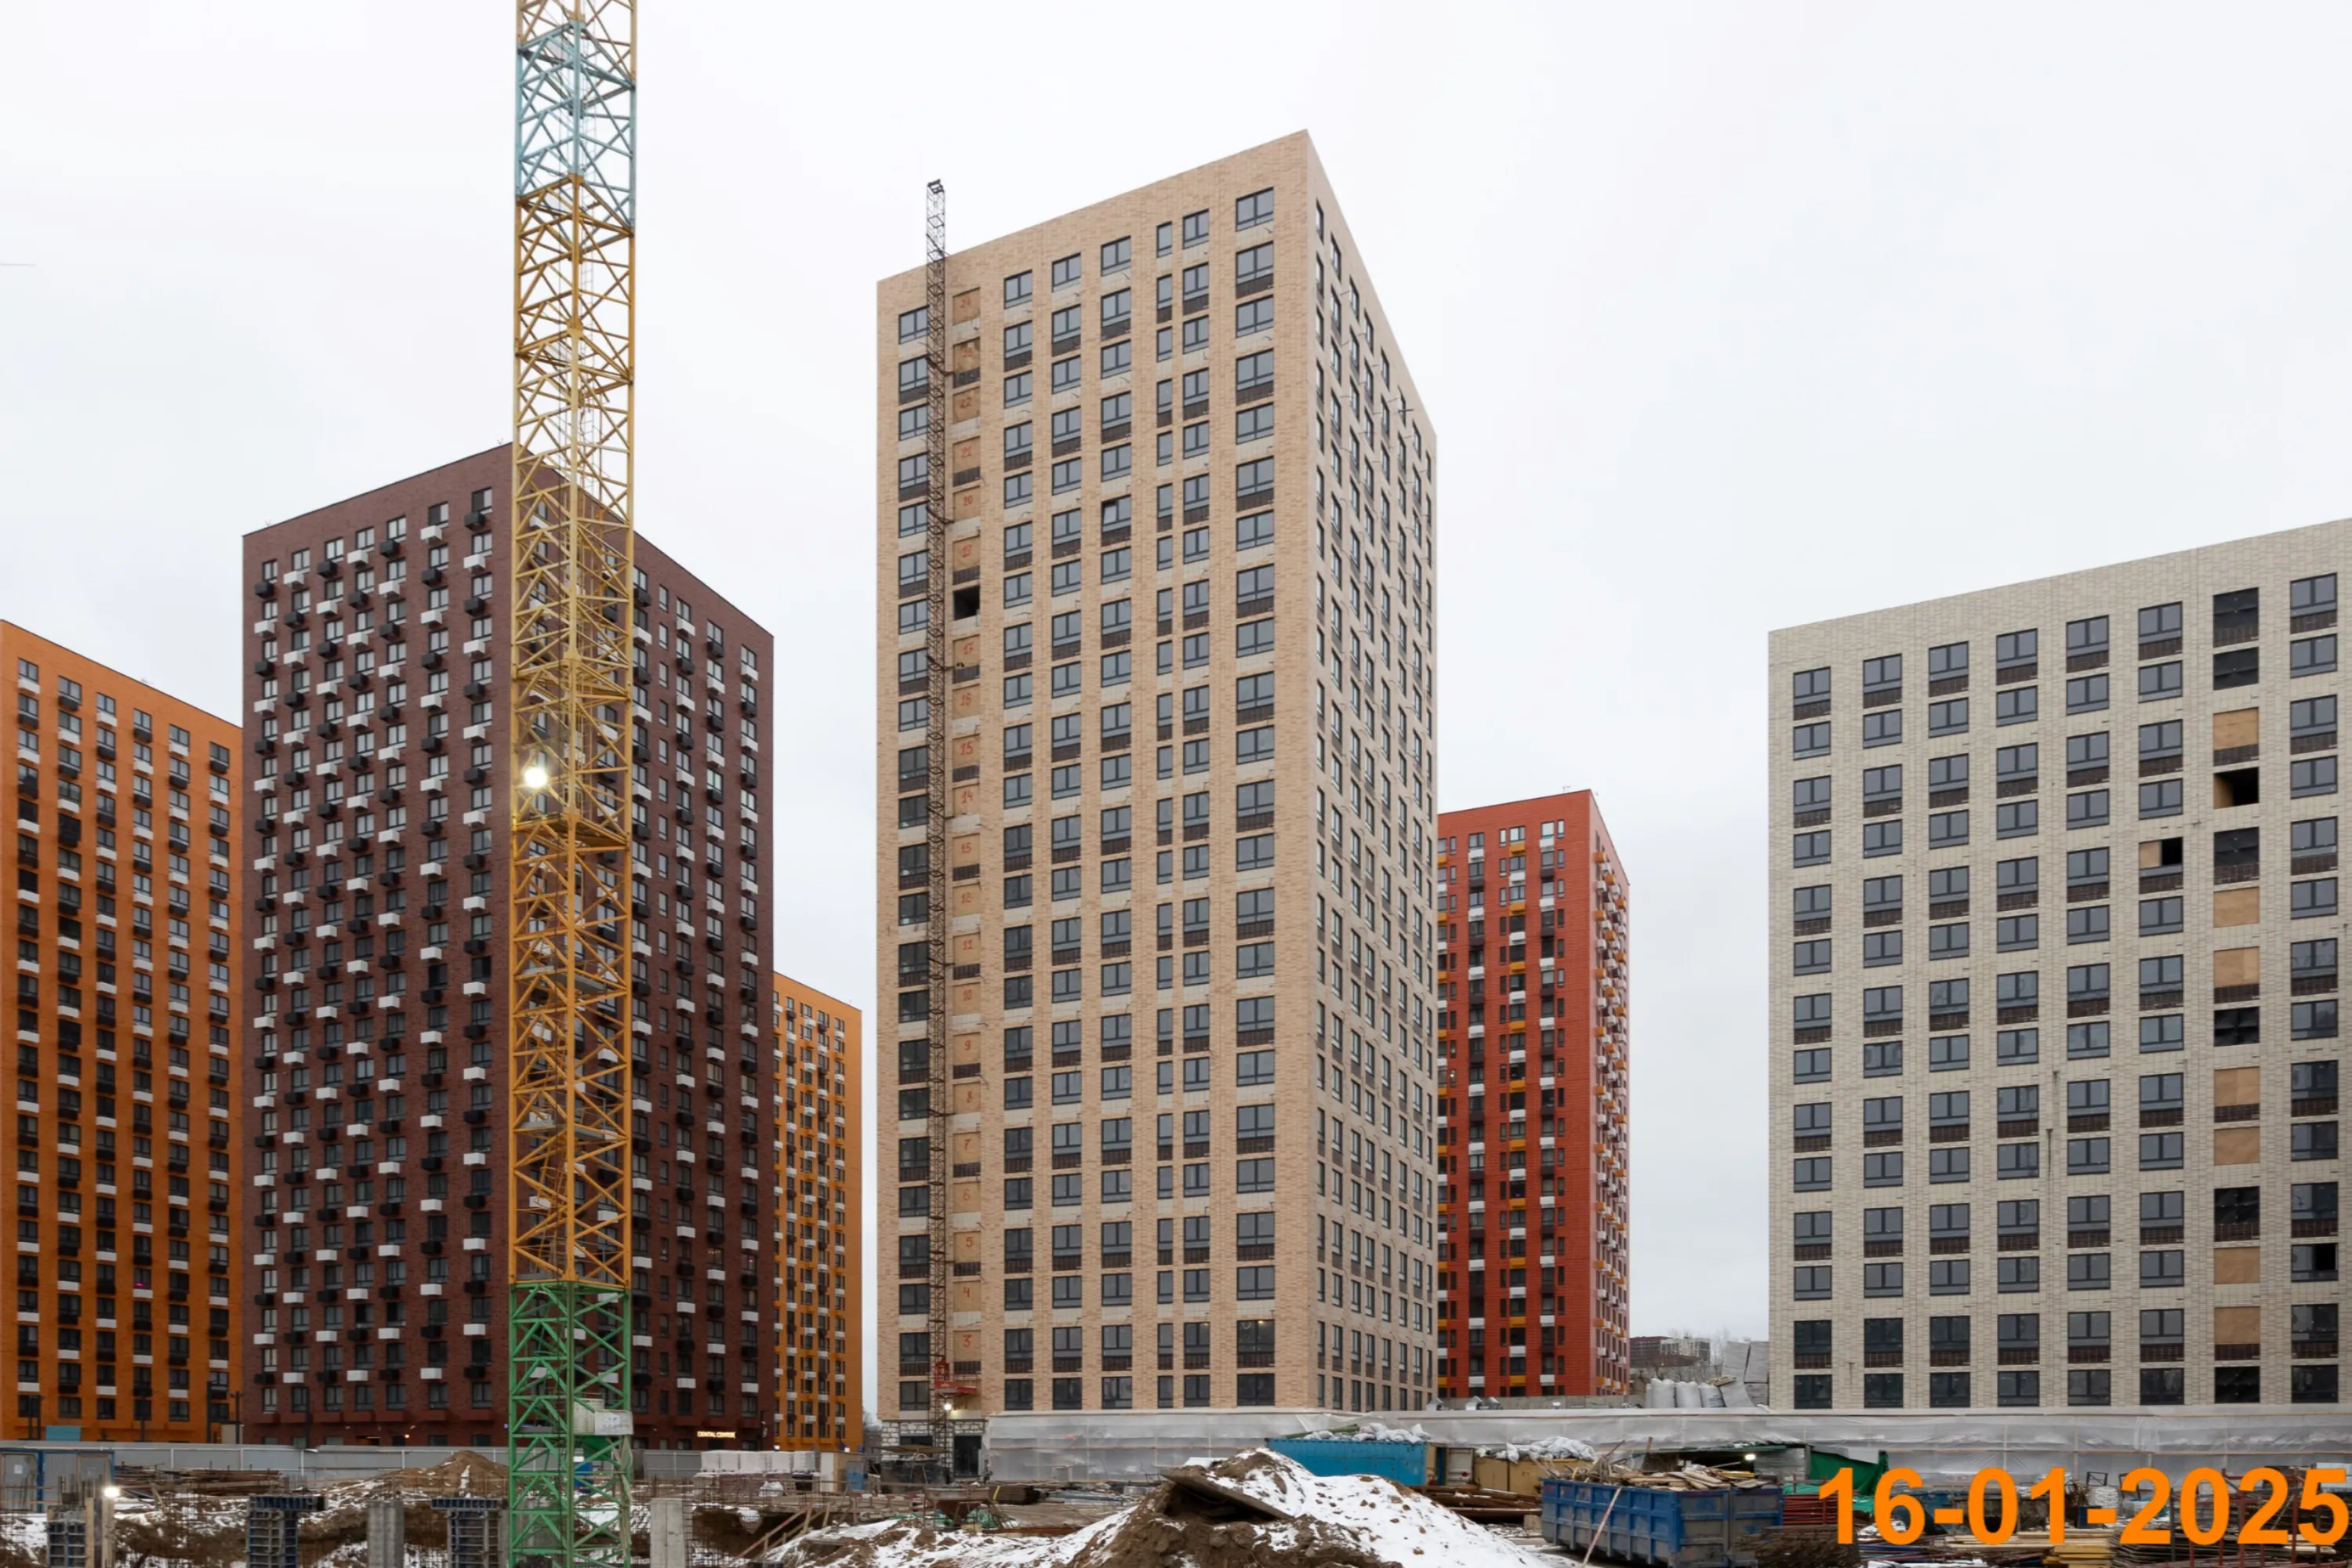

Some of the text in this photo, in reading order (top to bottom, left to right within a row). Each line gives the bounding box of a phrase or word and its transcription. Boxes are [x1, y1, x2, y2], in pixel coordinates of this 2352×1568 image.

[959, 397, 971, 408] 22
[960, 741, 973, 755] 15
[961, 790, 973, 804] 14
[961, 891, 971, 903] 12
[962, 939, 973, 949] 11
[963, 989, 972, 1001] 10
[964, 1040, 971, 1051] 9
[964, 1138, 971, 1150] 7
[963, 1189, 971, 1200] 6
[965, 1236, 975, 1247] 5
[963, 1286, 971, 1298] 4
[962, 1334, 972, 1348] 3
